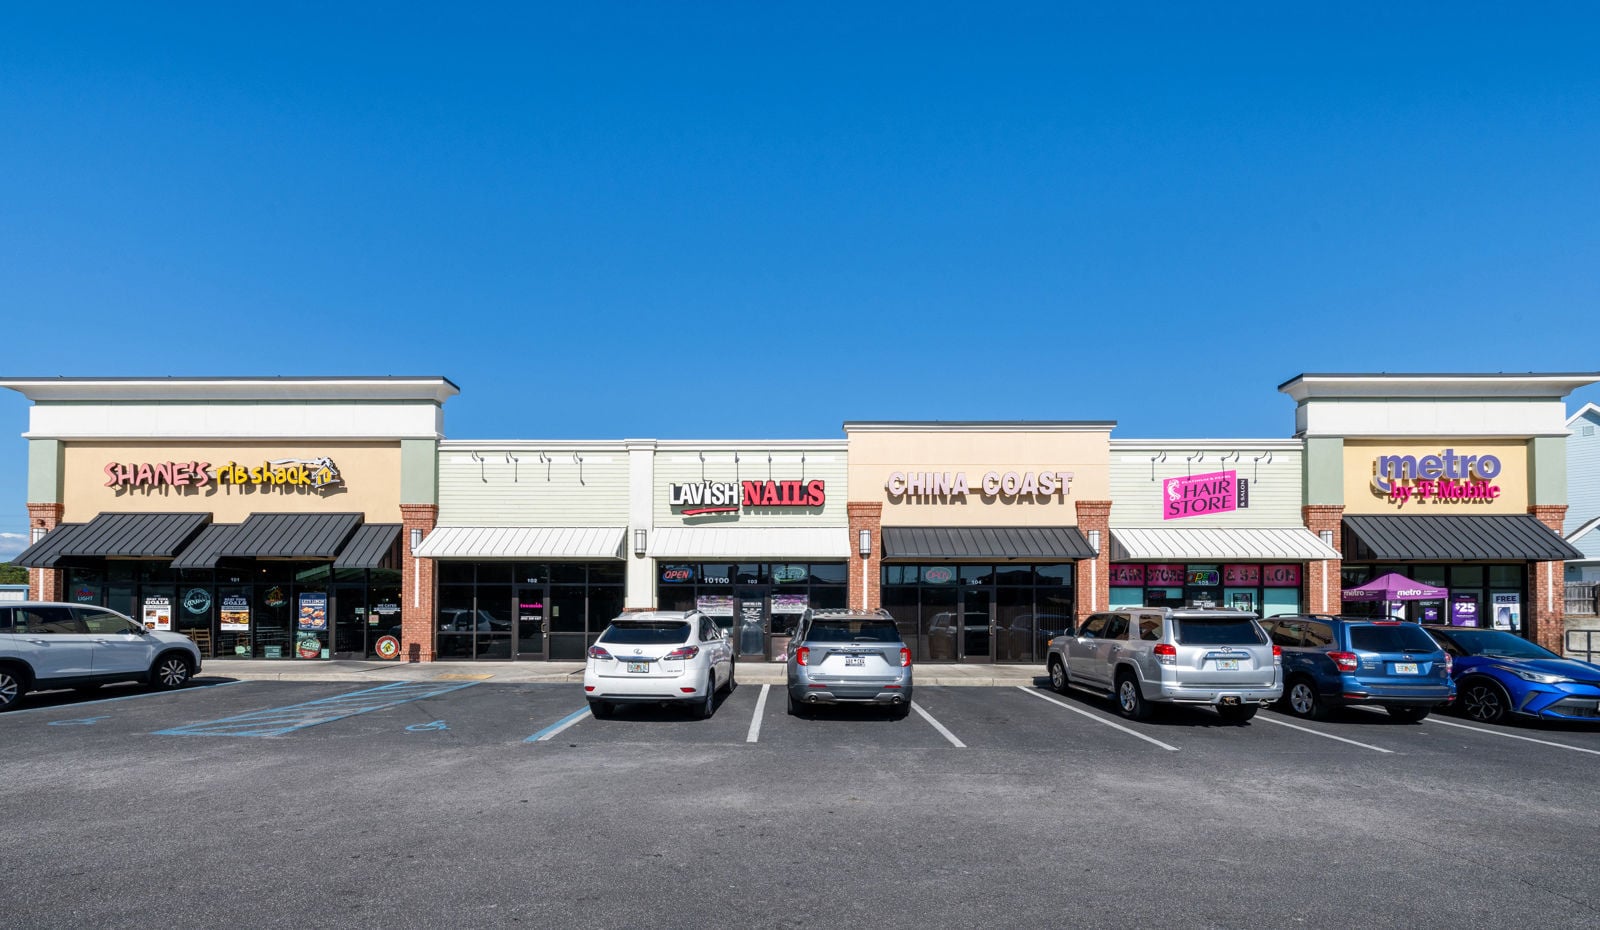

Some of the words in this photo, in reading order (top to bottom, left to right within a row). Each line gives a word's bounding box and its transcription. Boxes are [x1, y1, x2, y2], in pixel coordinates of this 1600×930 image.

[104, 461, 208, 487] SHANE'S
[251, 461, 312, 486] shack
[1375, 449, 1501, 486] metro
[669, 480, 739, 505] LAVISH
[742, 480, 825, 506] NAILS
[887, 471, 970, 496] CHINA
[982, 471, 1075, 496] COAST
[1183, 480, 1231, 499] HAIR
[1390, 481, 1414, 503] by
[1168, 494, 1232, 516] STORE
[665, 570, 689, 579] OPEN
[1109, 568, 1143, 582] HAIR
[1147, 568, 1184, 582] STORE
[1226, 568, 1236, 582] &
[1396, 588, 1422, 598] metro
[1455, 602, 1476, 613] $25
